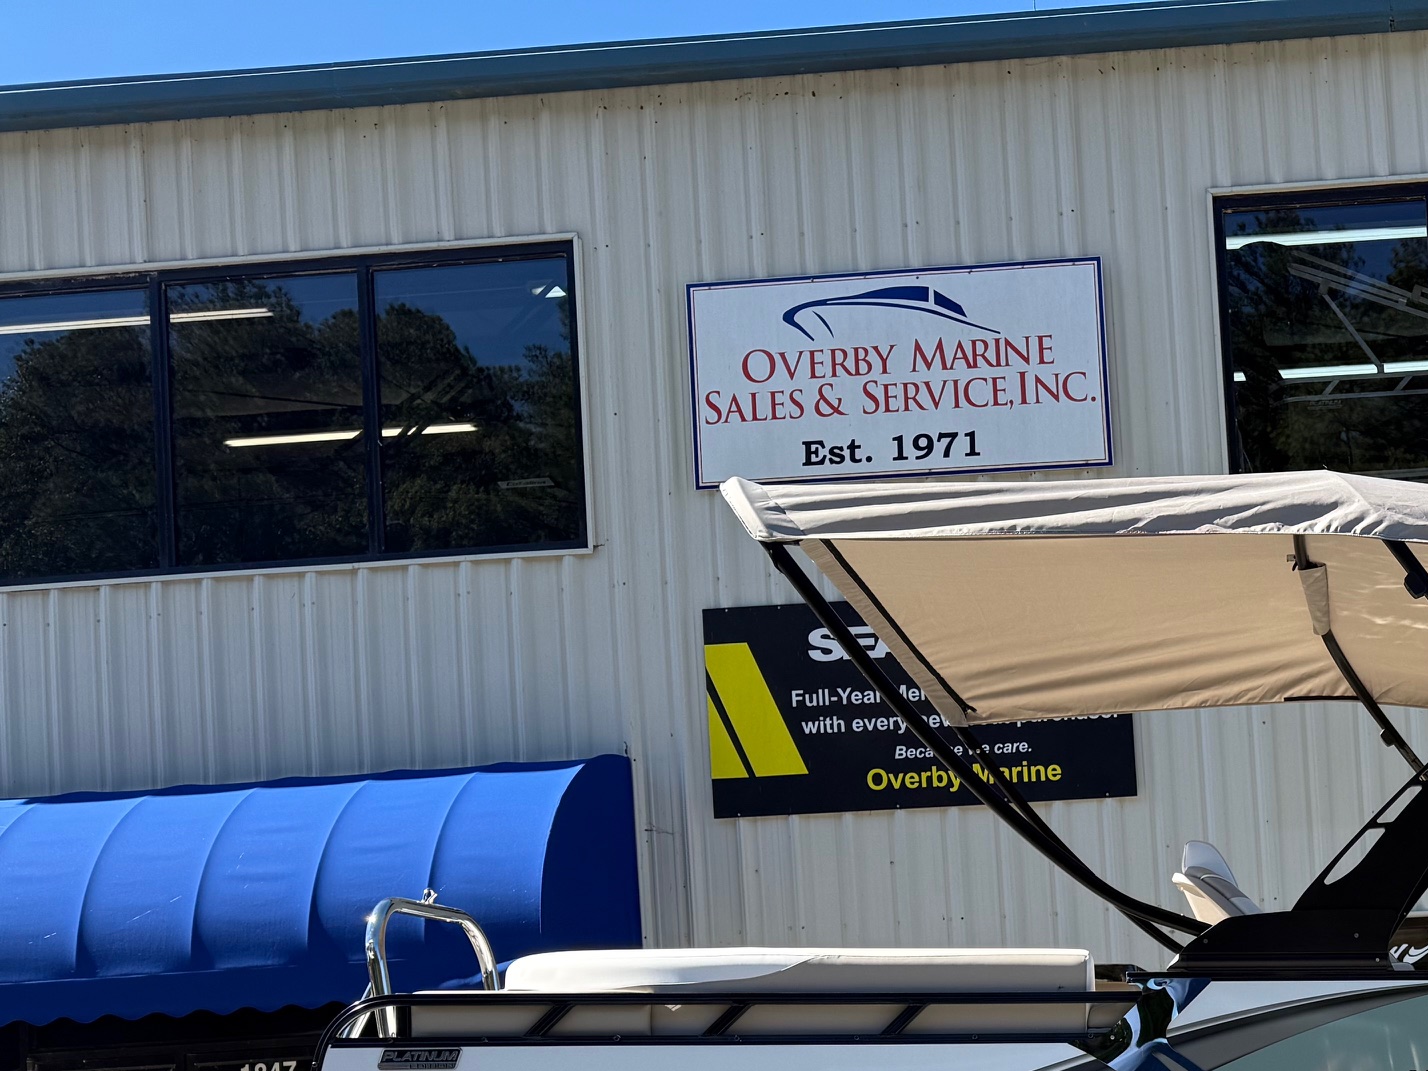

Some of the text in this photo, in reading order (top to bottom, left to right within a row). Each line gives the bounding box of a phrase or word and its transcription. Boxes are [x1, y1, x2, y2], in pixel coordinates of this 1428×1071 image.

[742, 334, 1055, 384] OVERBY MARINE
[705, 388, 804, 425] SALES
[814, 383, 849, 417] &
[802, 430, 980, 467] Est. 1971
[801, 716, 846, 734] with
[852, 714, 907, 734] every
[994, 741, 1032, 755] care.
[867, 764, 961, 793] Overby
[382, 1050, 459, 1062] PLATINUM
